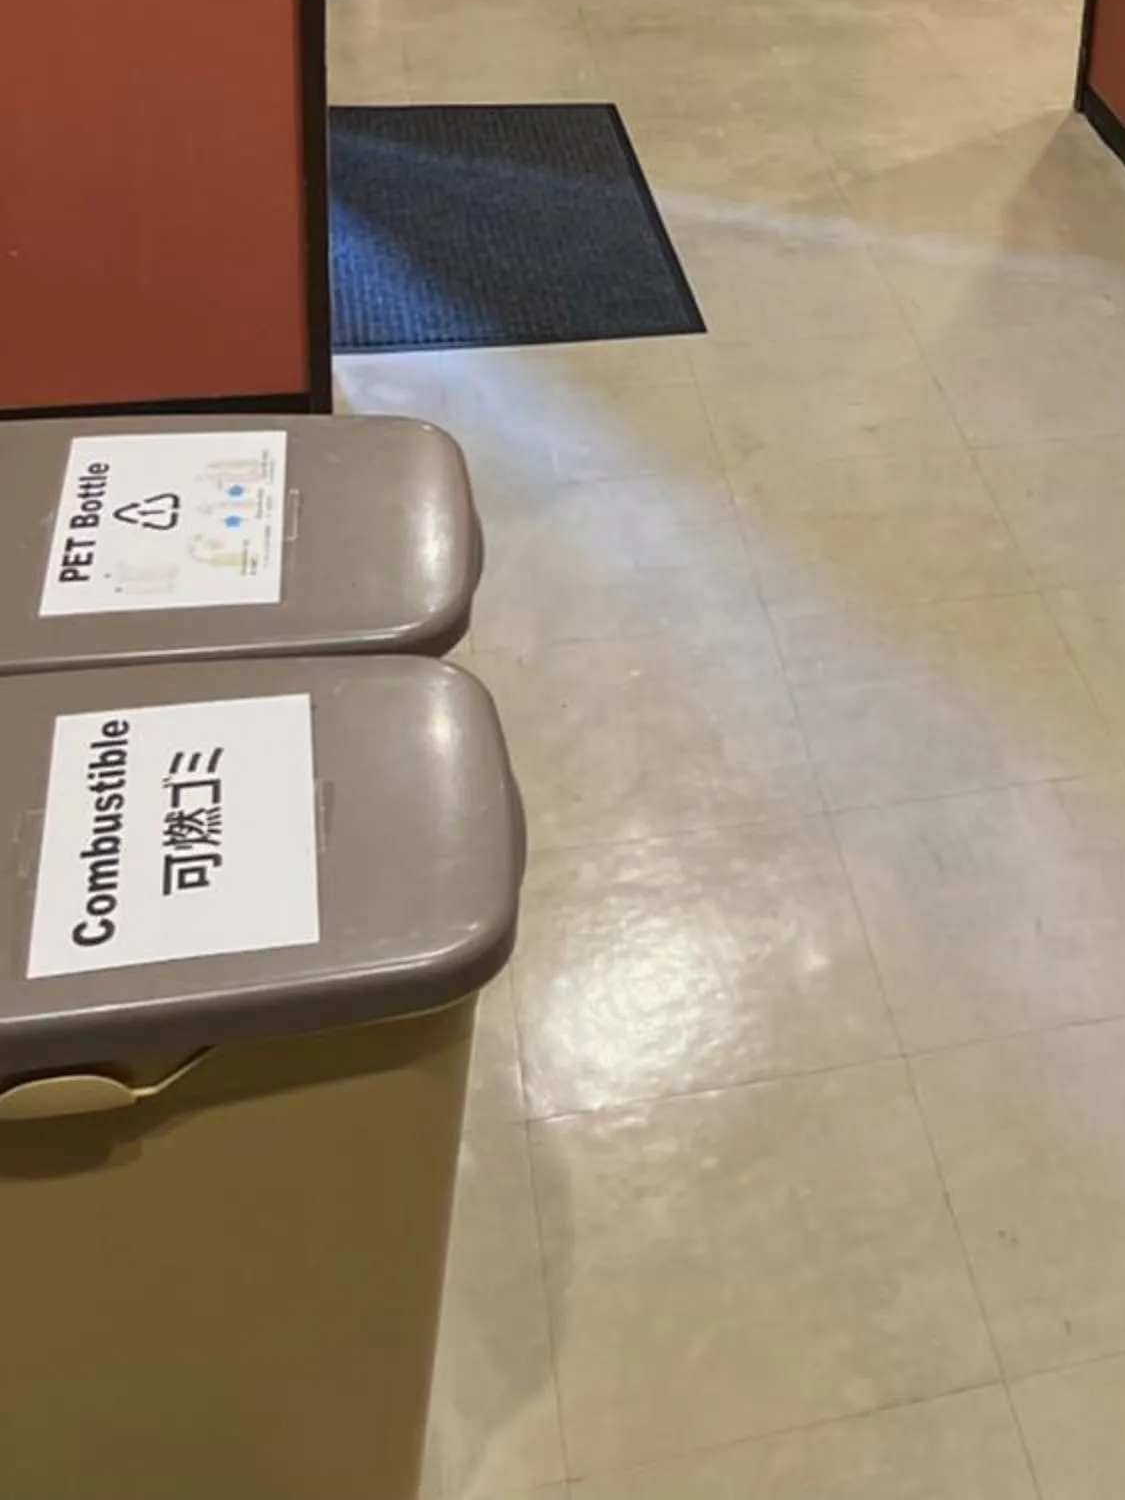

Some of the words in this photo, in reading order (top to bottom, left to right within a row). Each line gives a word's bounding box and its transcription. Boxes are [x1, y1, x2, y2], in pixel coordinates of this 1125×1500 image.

[69, 460, 111, 530] Bottle
[58, 537, 95, 585] PET
[72, 718, 131, 948] Combustible
[161, 746, 224, 897] 可燃ゴミ
